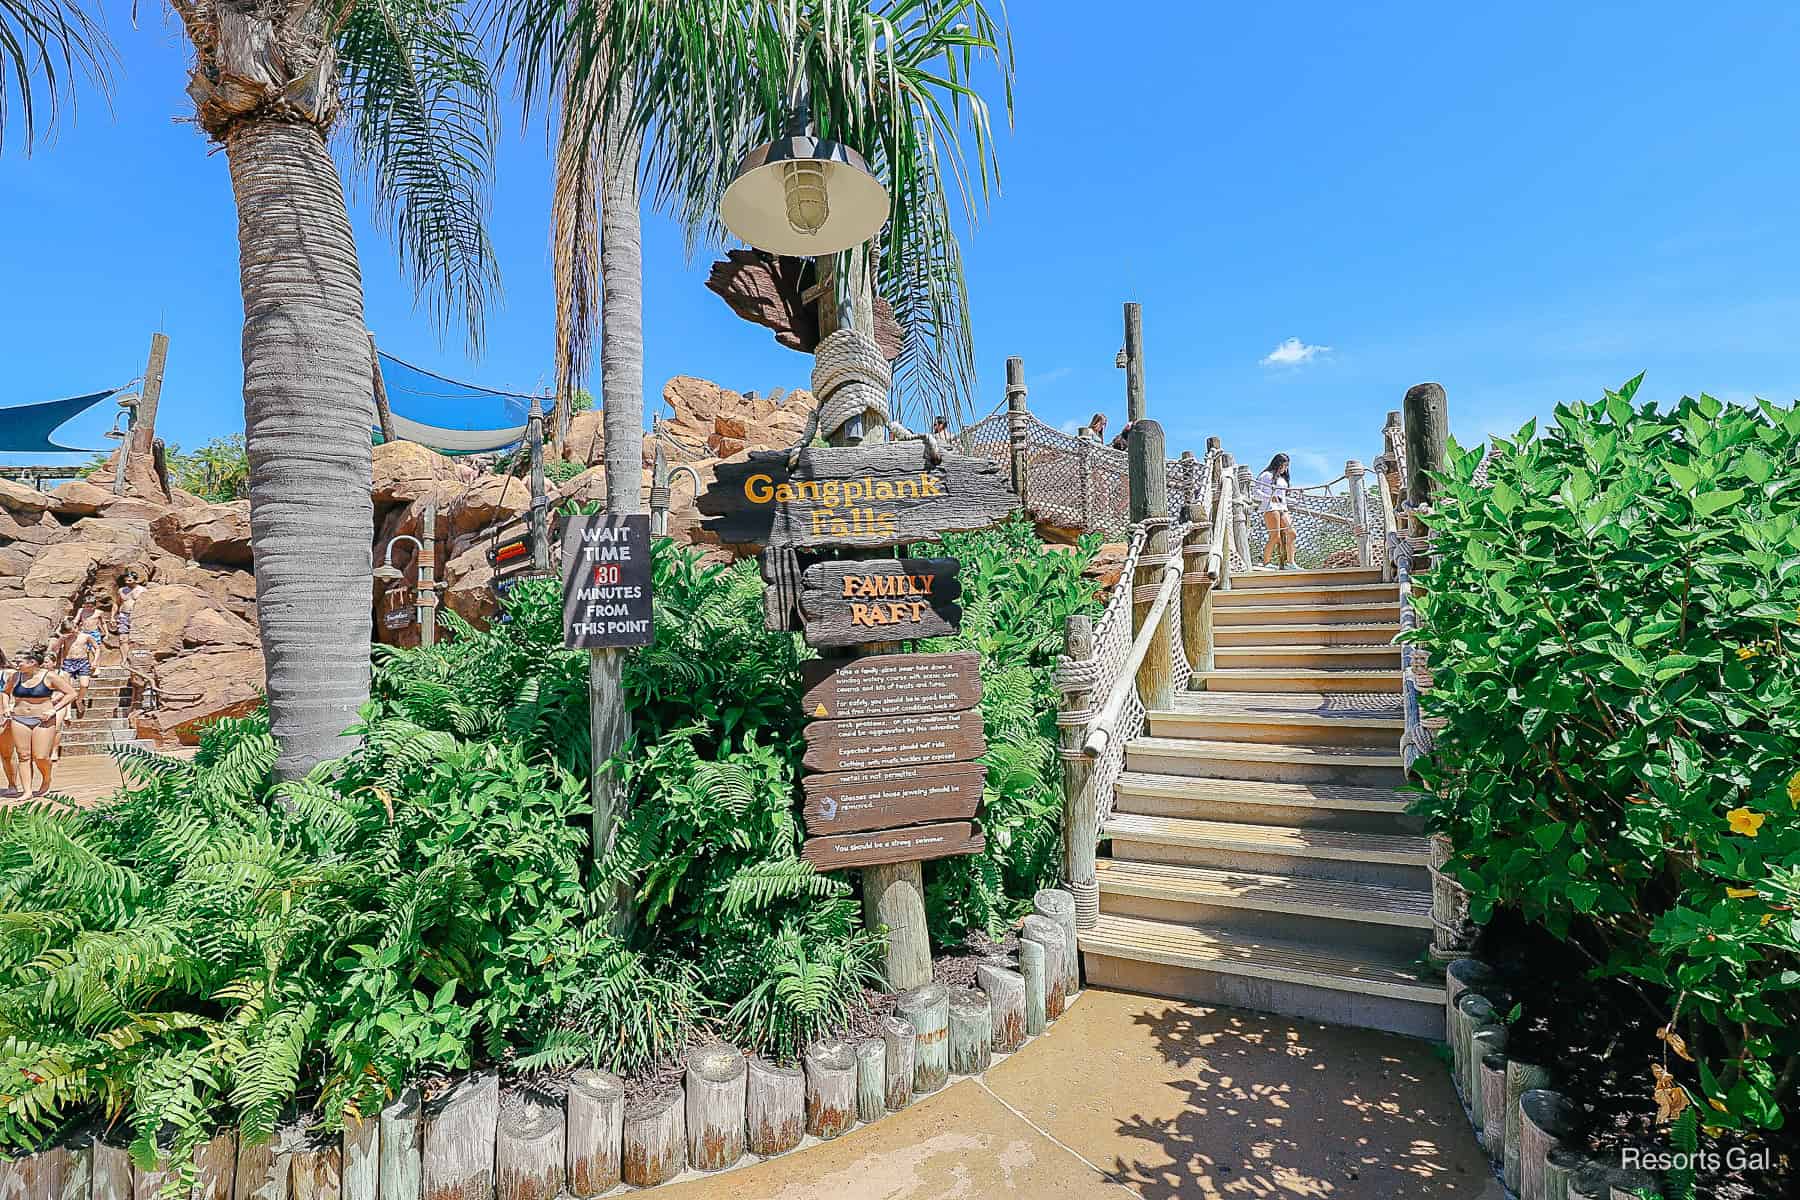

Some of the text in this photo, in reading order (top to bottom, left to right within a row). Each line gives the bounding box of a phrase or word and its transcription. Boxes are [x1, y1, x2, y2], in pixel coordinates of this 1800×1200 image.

[744, 472, 942, 509] Gangplank
[811, 507, 896, 537] Falls
[580, 527, 631, 542] WAIT
[583, 546, 632, 562] TIME
[598, 566, 619, 584] 30
[576, 586, 642, 601] MINUTES
[842, 575, 935, 598] FAMILY
[586, 603, 629, 618] FROM
[850, 601, 926, 627] RAFT
[572, 619, 650, 636] THIS POINT
[870, 698, 882, 706] you
[883, 695, 904, 704] should
[907, 726, 915, 734] by
[916, 724, 928, 732] this
[838, 759, 865, 768] Clothing
[870, 772, 881, 780] not
[928, 785, 950, 794] should
[834, 844, 849, 852] You
[849, 841, 873, 851] should
[874, 841, 884, 849] be
